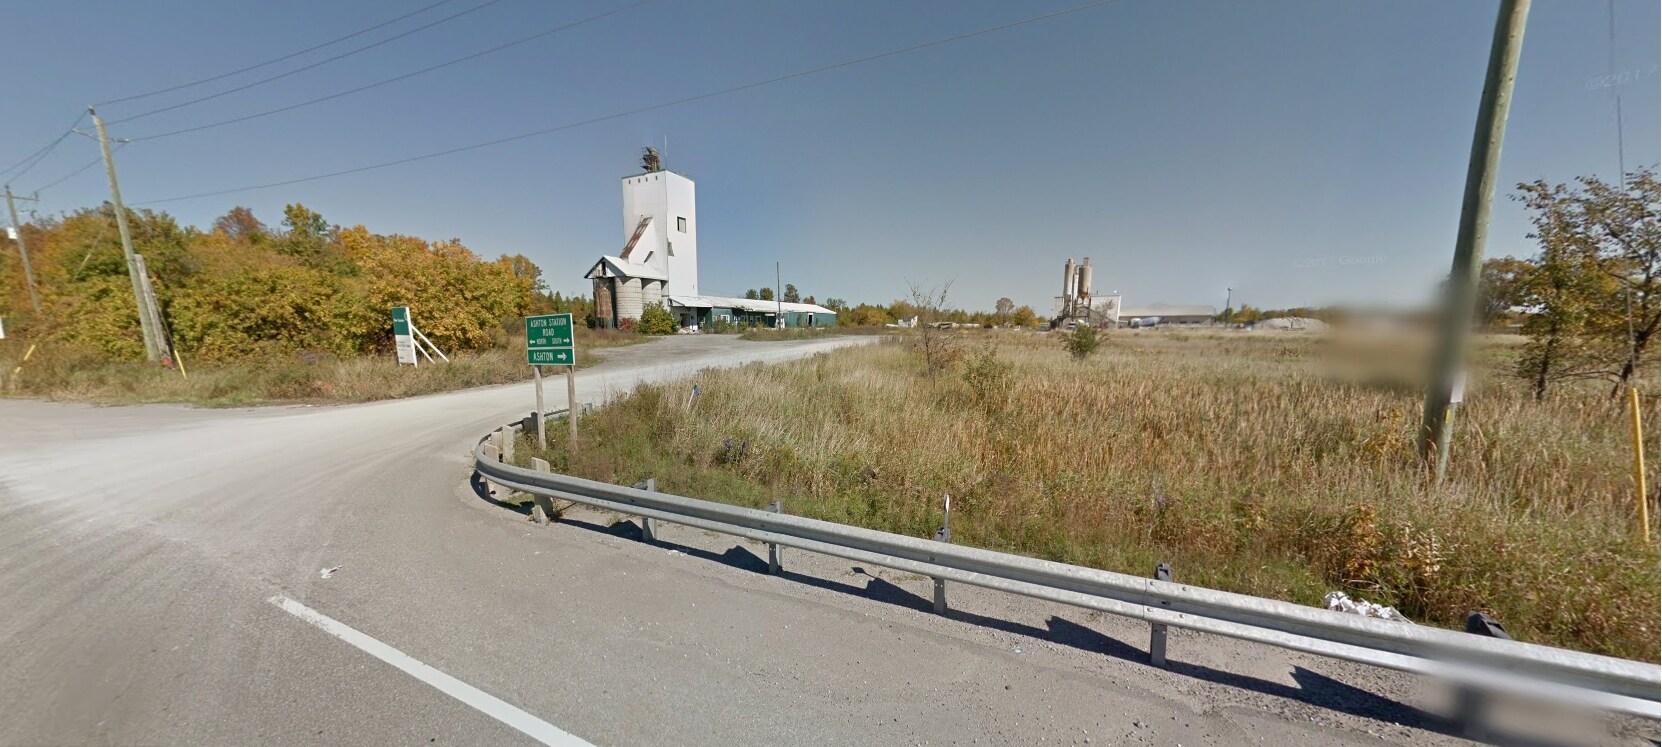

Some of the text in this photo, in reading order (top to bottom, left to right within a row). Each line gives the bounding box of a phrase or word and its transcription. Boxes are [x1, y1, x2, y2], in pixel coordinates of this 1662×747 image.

[530, 317, 567, 328] ASHTON STATION
[542, 328, 555, 336] ROAD
[551, 337, 562, 345] SOUTH
[533, 352, 554, 361] ASHTON
